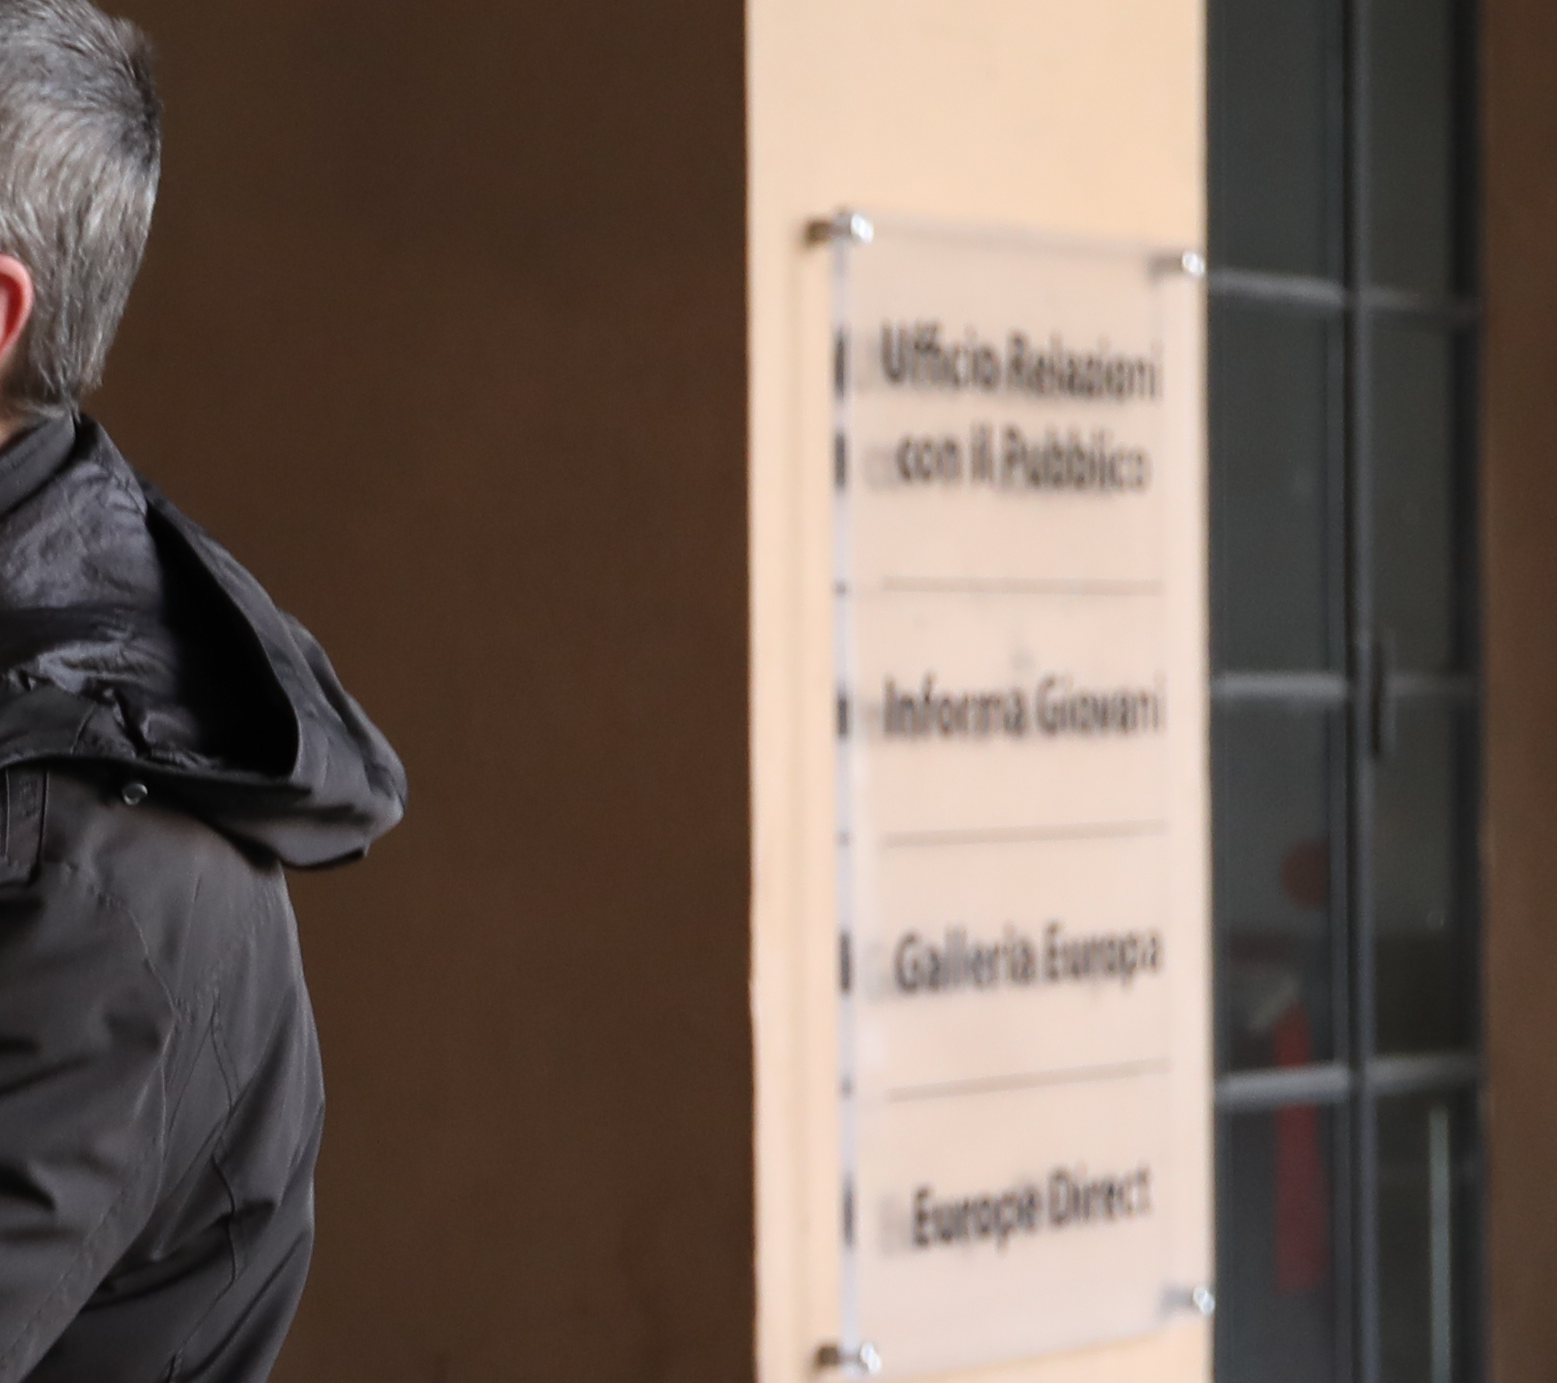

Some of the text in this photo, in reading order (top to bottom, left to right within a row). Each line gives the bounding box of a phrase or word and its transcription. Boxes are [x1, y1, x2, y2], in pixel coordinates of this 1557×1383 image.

[881, 318, 1164, 401] Ufficio Relazioni
[896, 433, 962, 484] con
[1001, 422, 1152, 492] Pubblico
[1035, 671, 1167, 737] Giovani
[894, 919, 1164, 994] Galleria Europa
[1048, 1162, 1153, 1228] Direct
